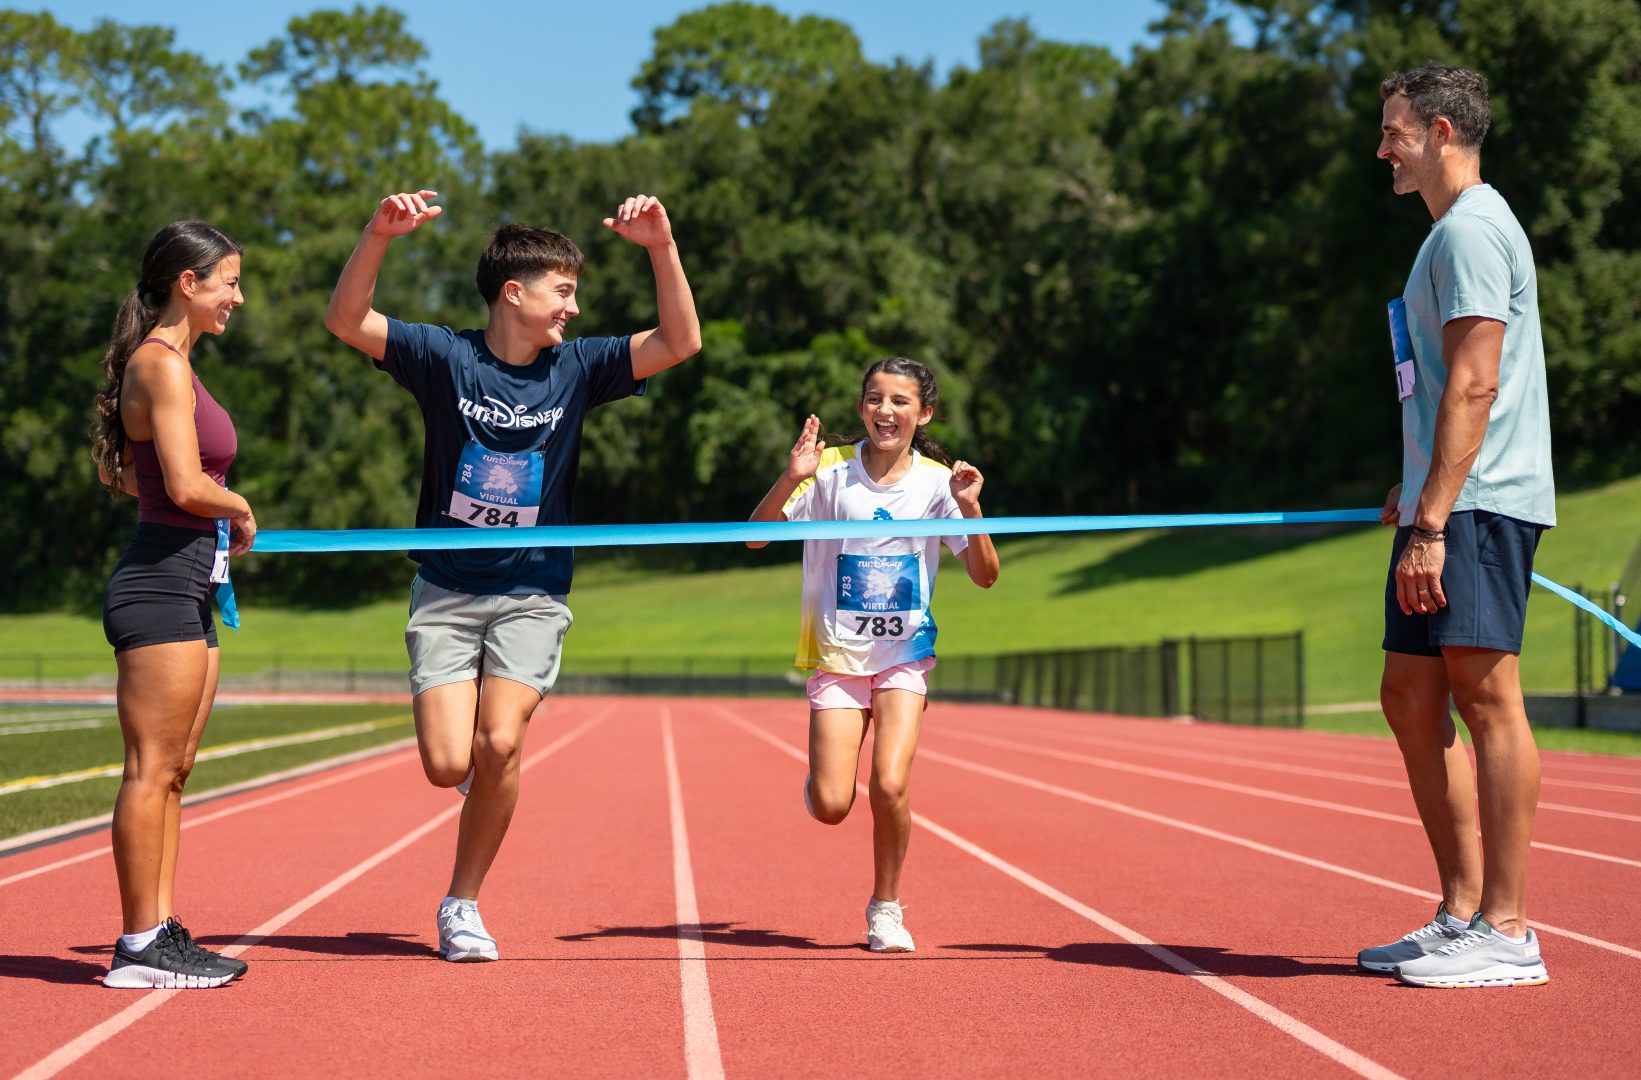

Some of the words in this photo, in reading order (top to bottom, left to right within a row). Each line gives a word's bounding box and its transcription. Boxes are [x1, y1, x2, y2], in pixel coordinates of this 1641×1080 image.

[461, 463, 474, 485] 784
[479, 491, 519, 505] VIRTUAL
[467, 502, 519, 527] 784
[842, 575, 852, 597] 783
[861, 601, 900, 610] VIRTUAL
[855, 616, 904, 637] 783
